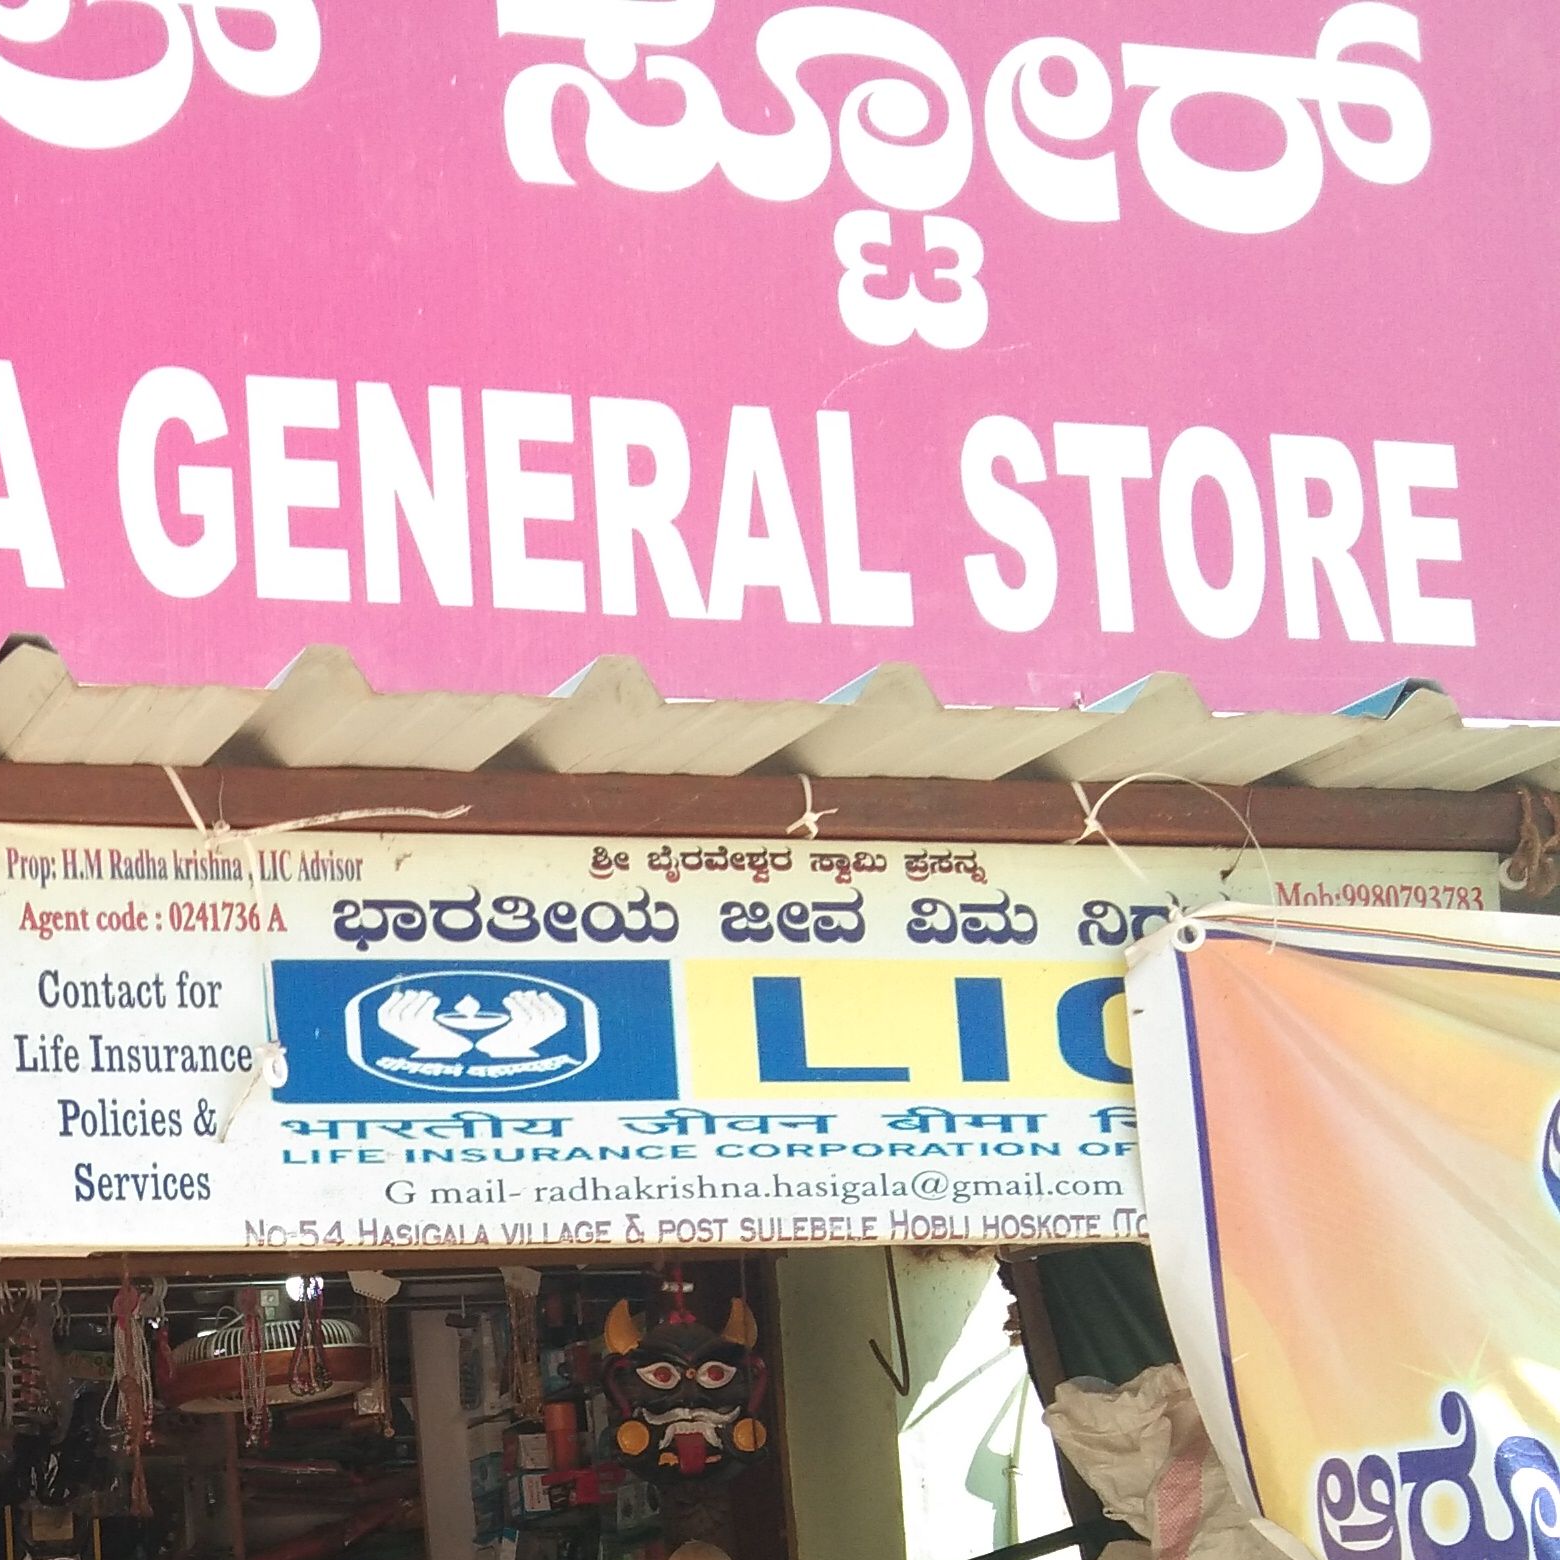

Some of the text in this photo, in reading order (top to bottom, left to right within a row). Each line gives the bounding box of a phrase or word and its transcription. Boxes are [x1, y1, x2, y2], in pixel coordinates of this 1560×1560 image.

[117, 364, 914, 629] GENERAL
[959, 414, 1476, 648] STORE
[5, 846, 58, 888] Prop:
[61, 848, 105, 881] H.M
[108, 848, 169, 882] Radha
[172, 848, 243, 883] krishna
[258, 851, 293, 882] LIC
[296, 850, 365, 883] Advisor
[19, 901, 91, 940] Agent
[96, 903, 149, 933] code
[168, 902, 262, 933] 0241736
[266, 903, 289, 933] A
[332, 884, 681, 952] ಭಾರತೀಯ
[38, 968, 223, 1010] Contact for
[13, 1033, 254, 1074] Life Insurance
[57, 1097, 219, 1139] Policies &
[281, 1106, 1047, 1141] भारतीय जीवन बीमा
[282, 1147, 386, 1165] LIFE
[405, 1144, 697, 1164] INSURANCE
[715, 1141, 1062, 1160] CORPORATION
[73, 1162, 212, 1203] Services
[533, 1169, 1125, 1205] radhakrishna.hasigala@gmail.com
[624, 1213, 645, 1245] &
